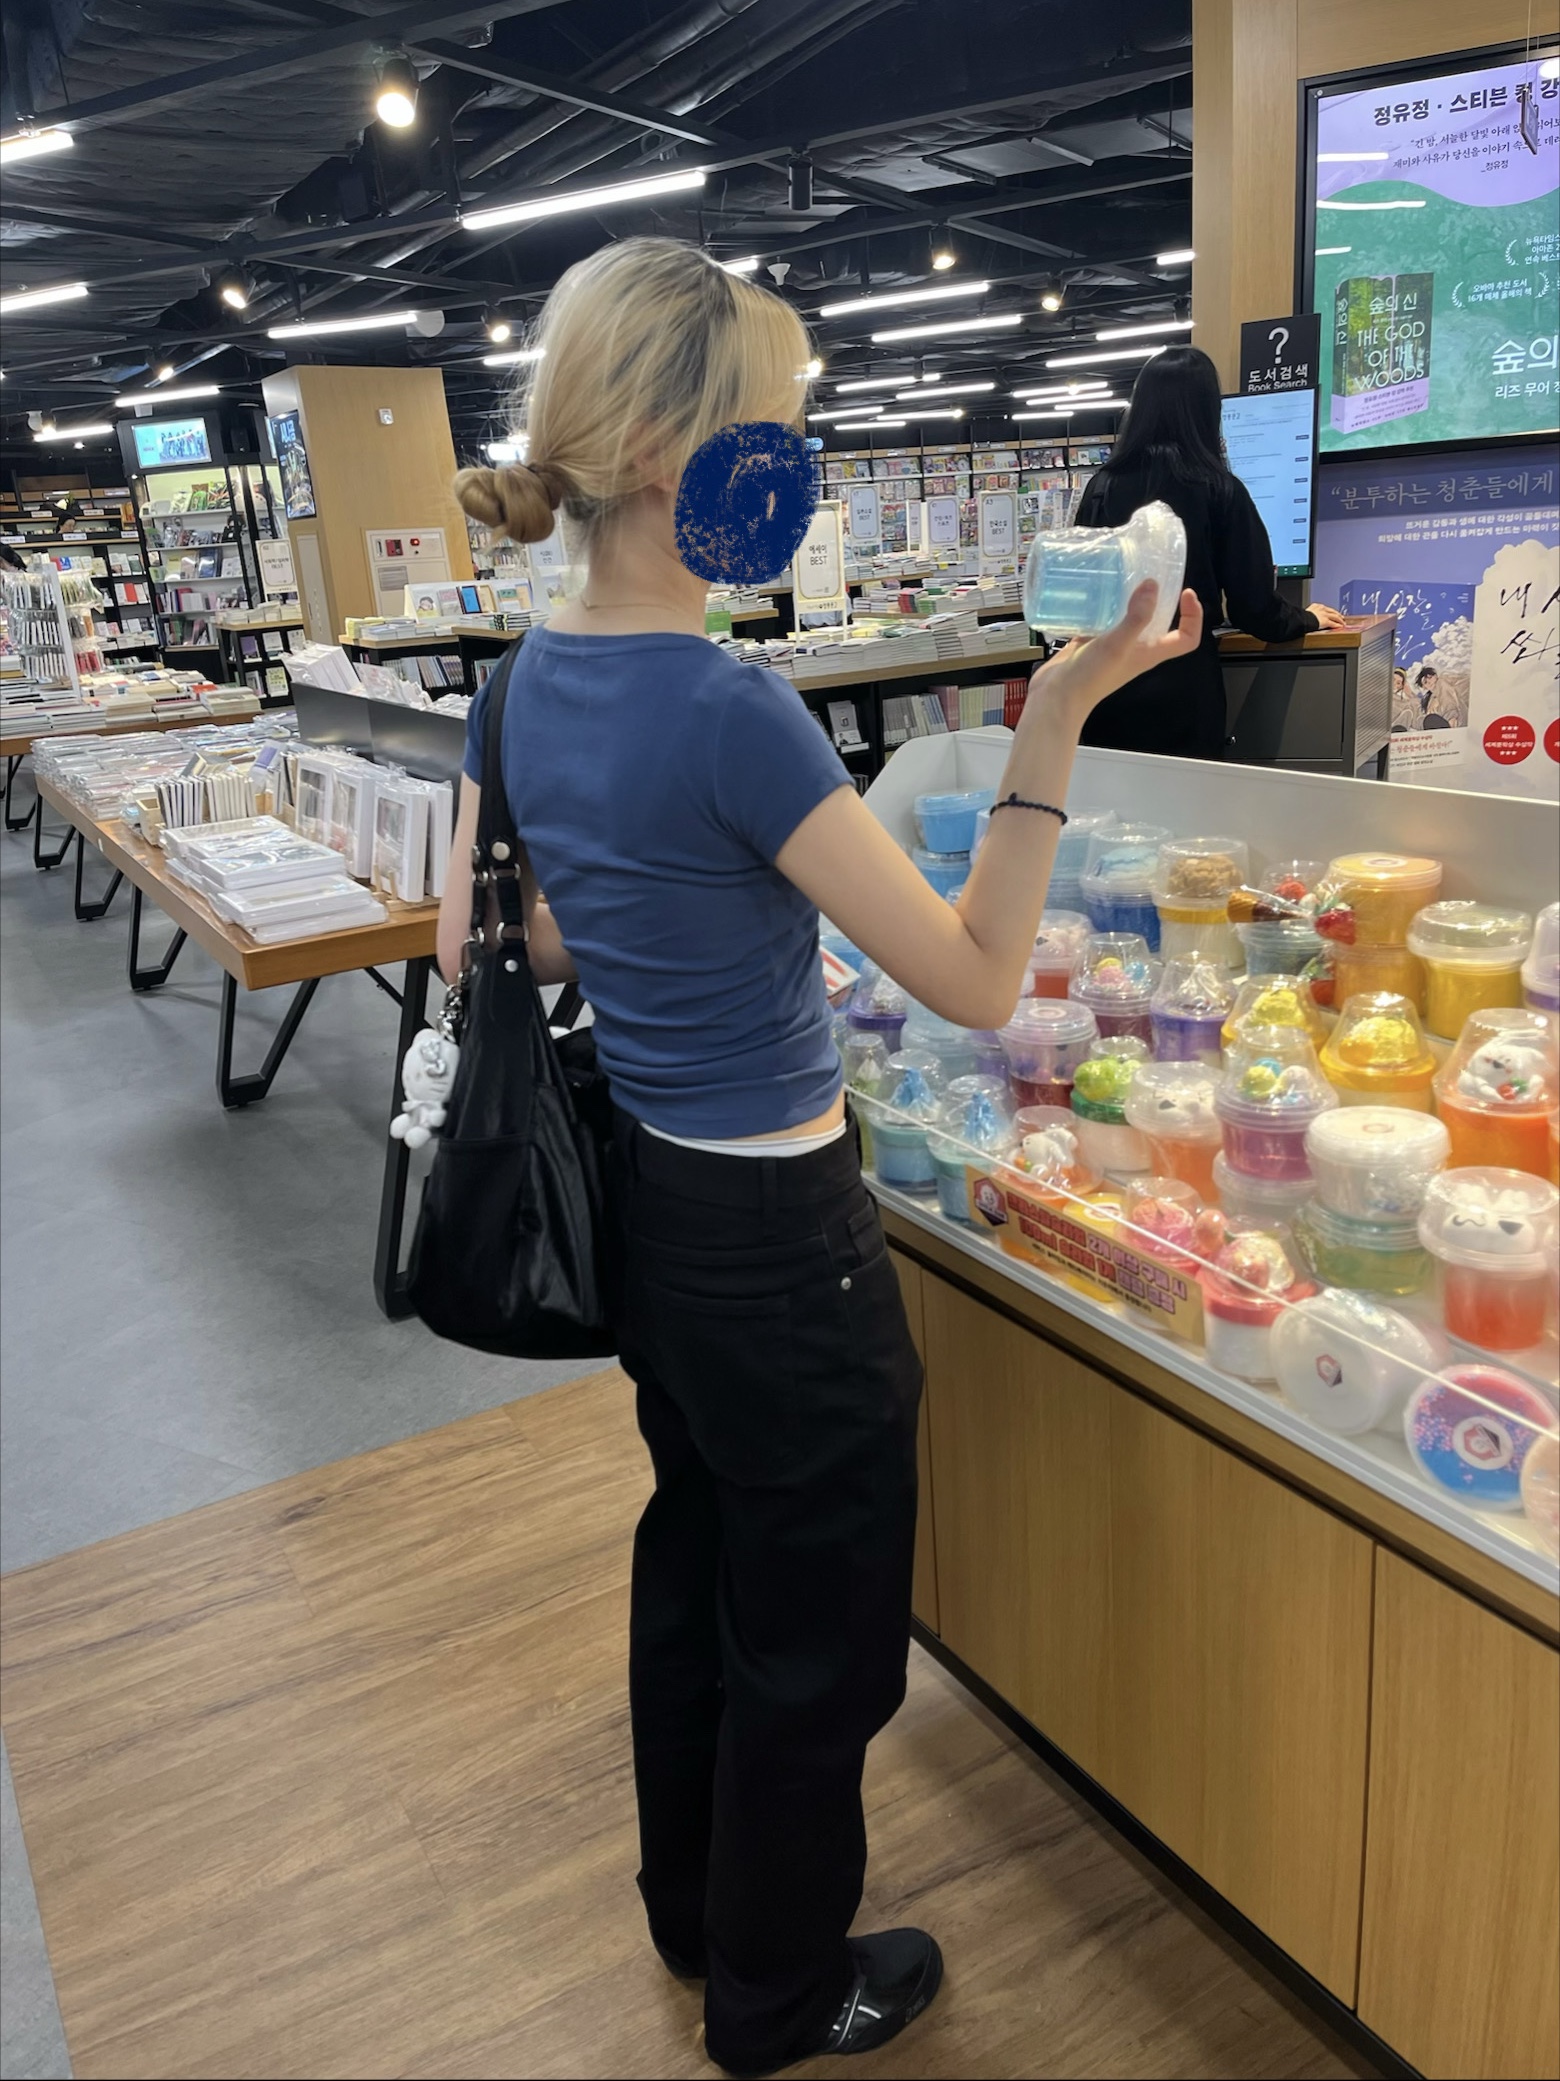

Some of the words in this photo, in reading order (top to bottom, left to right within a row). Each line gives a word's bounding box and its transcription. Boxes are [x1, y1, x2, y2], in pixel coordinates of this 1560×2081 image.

[1374, 99, 1429, 126] 정유정
[1449, 86, 1508, 113] 스티븐
[1440, 131, 1468, 145] 서늘한
[1471, 127, 1489, 141] 달빛
[1491, 124, 1510, 138] 아래
[1422, 151, 1449, 165] 사유가
[1452, 146, 1480, 160] 당신을
[1482, 141, 1509, 157] 이야기
[1473, 282, 1494, 293] 오바마
[1496, 280, 1511, 290] 추천
[1512, 278, 1528, 288] 도서
[1369, 295, 1399, 315] 숲의
[1403, 292, 1417, 311] 신
[1357, 328, 1379, 347] THE
[1385, 321, 1425, 341] GOD
[1368, 348, 1389, 367] OF
[1491, 334, 1559, 375] 숲의
[1248, 383, 1271, 393] Book
[1273, 378, 1308, 390] Search
[1353, 362, 1425, 391] WOODS
[1495, 384, 1521, 399] 리즈
[1524, 380, 1550, 397] 무어
[1331, 481, 1431, 511] “분투하는
[1435, 469, 1554, 503] 청춘들에게
[809, 544, 827, 555] 에세이
[810, 556, 827, 565] BEST
[1500, 582, 1532, 618] 내
